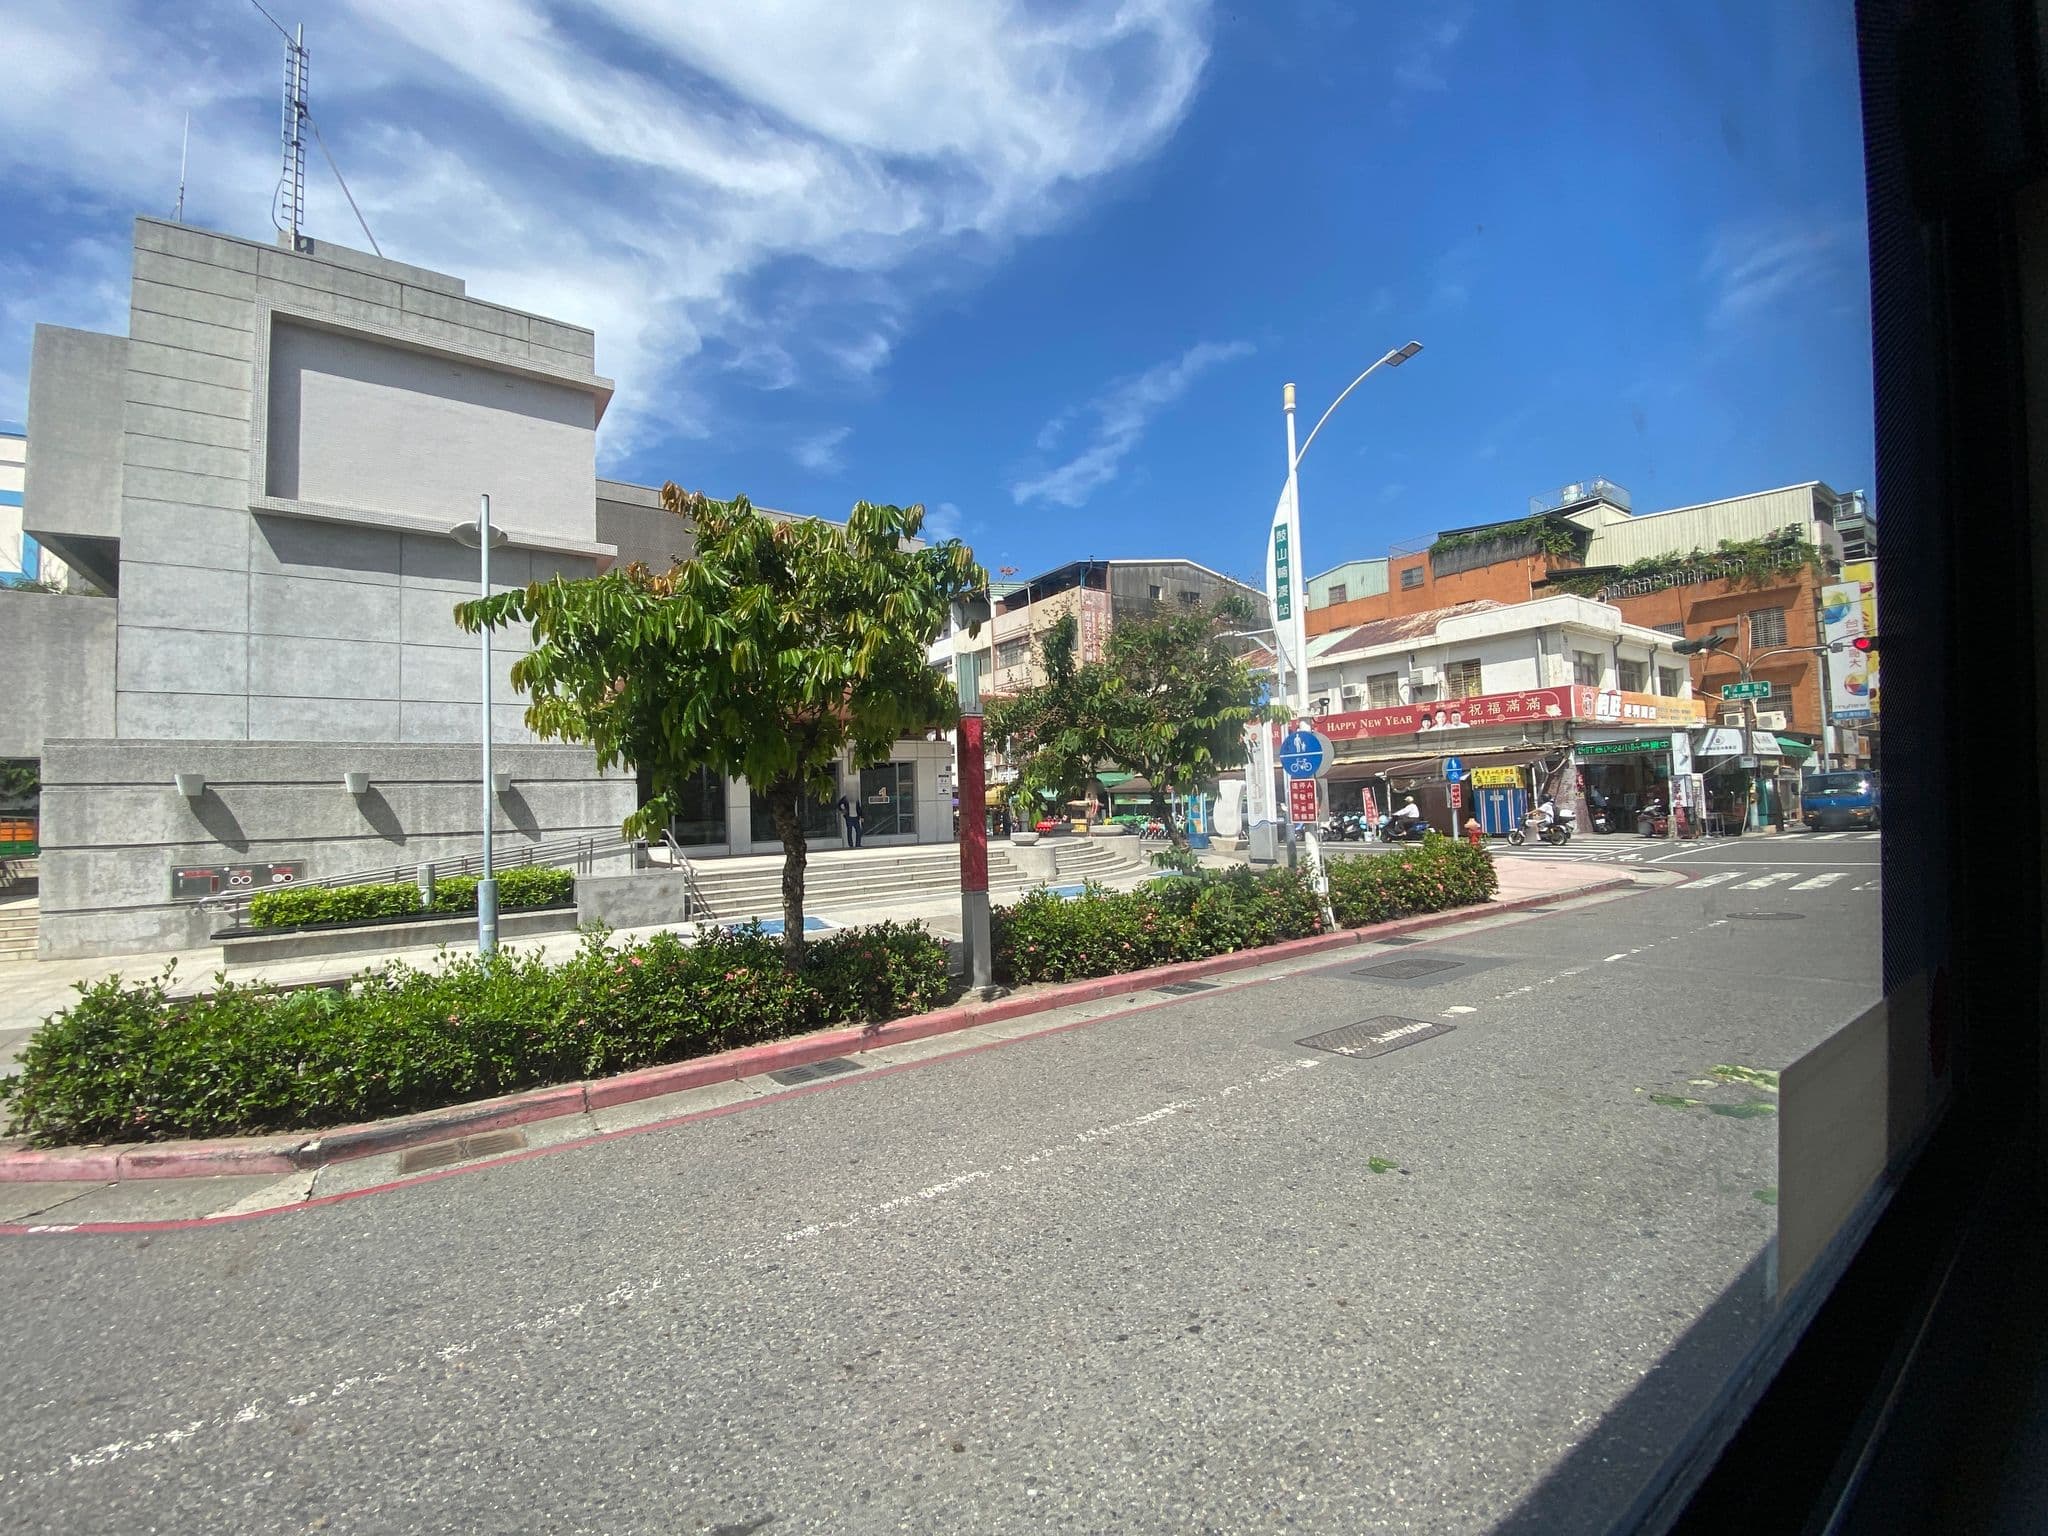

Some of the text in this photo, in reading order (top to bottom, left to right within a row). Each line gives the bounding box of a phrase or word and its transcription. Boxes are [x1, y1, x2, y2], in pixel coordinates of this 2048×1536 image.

[1327, 715, 1413, 732] HAPPY NEW YEAR
